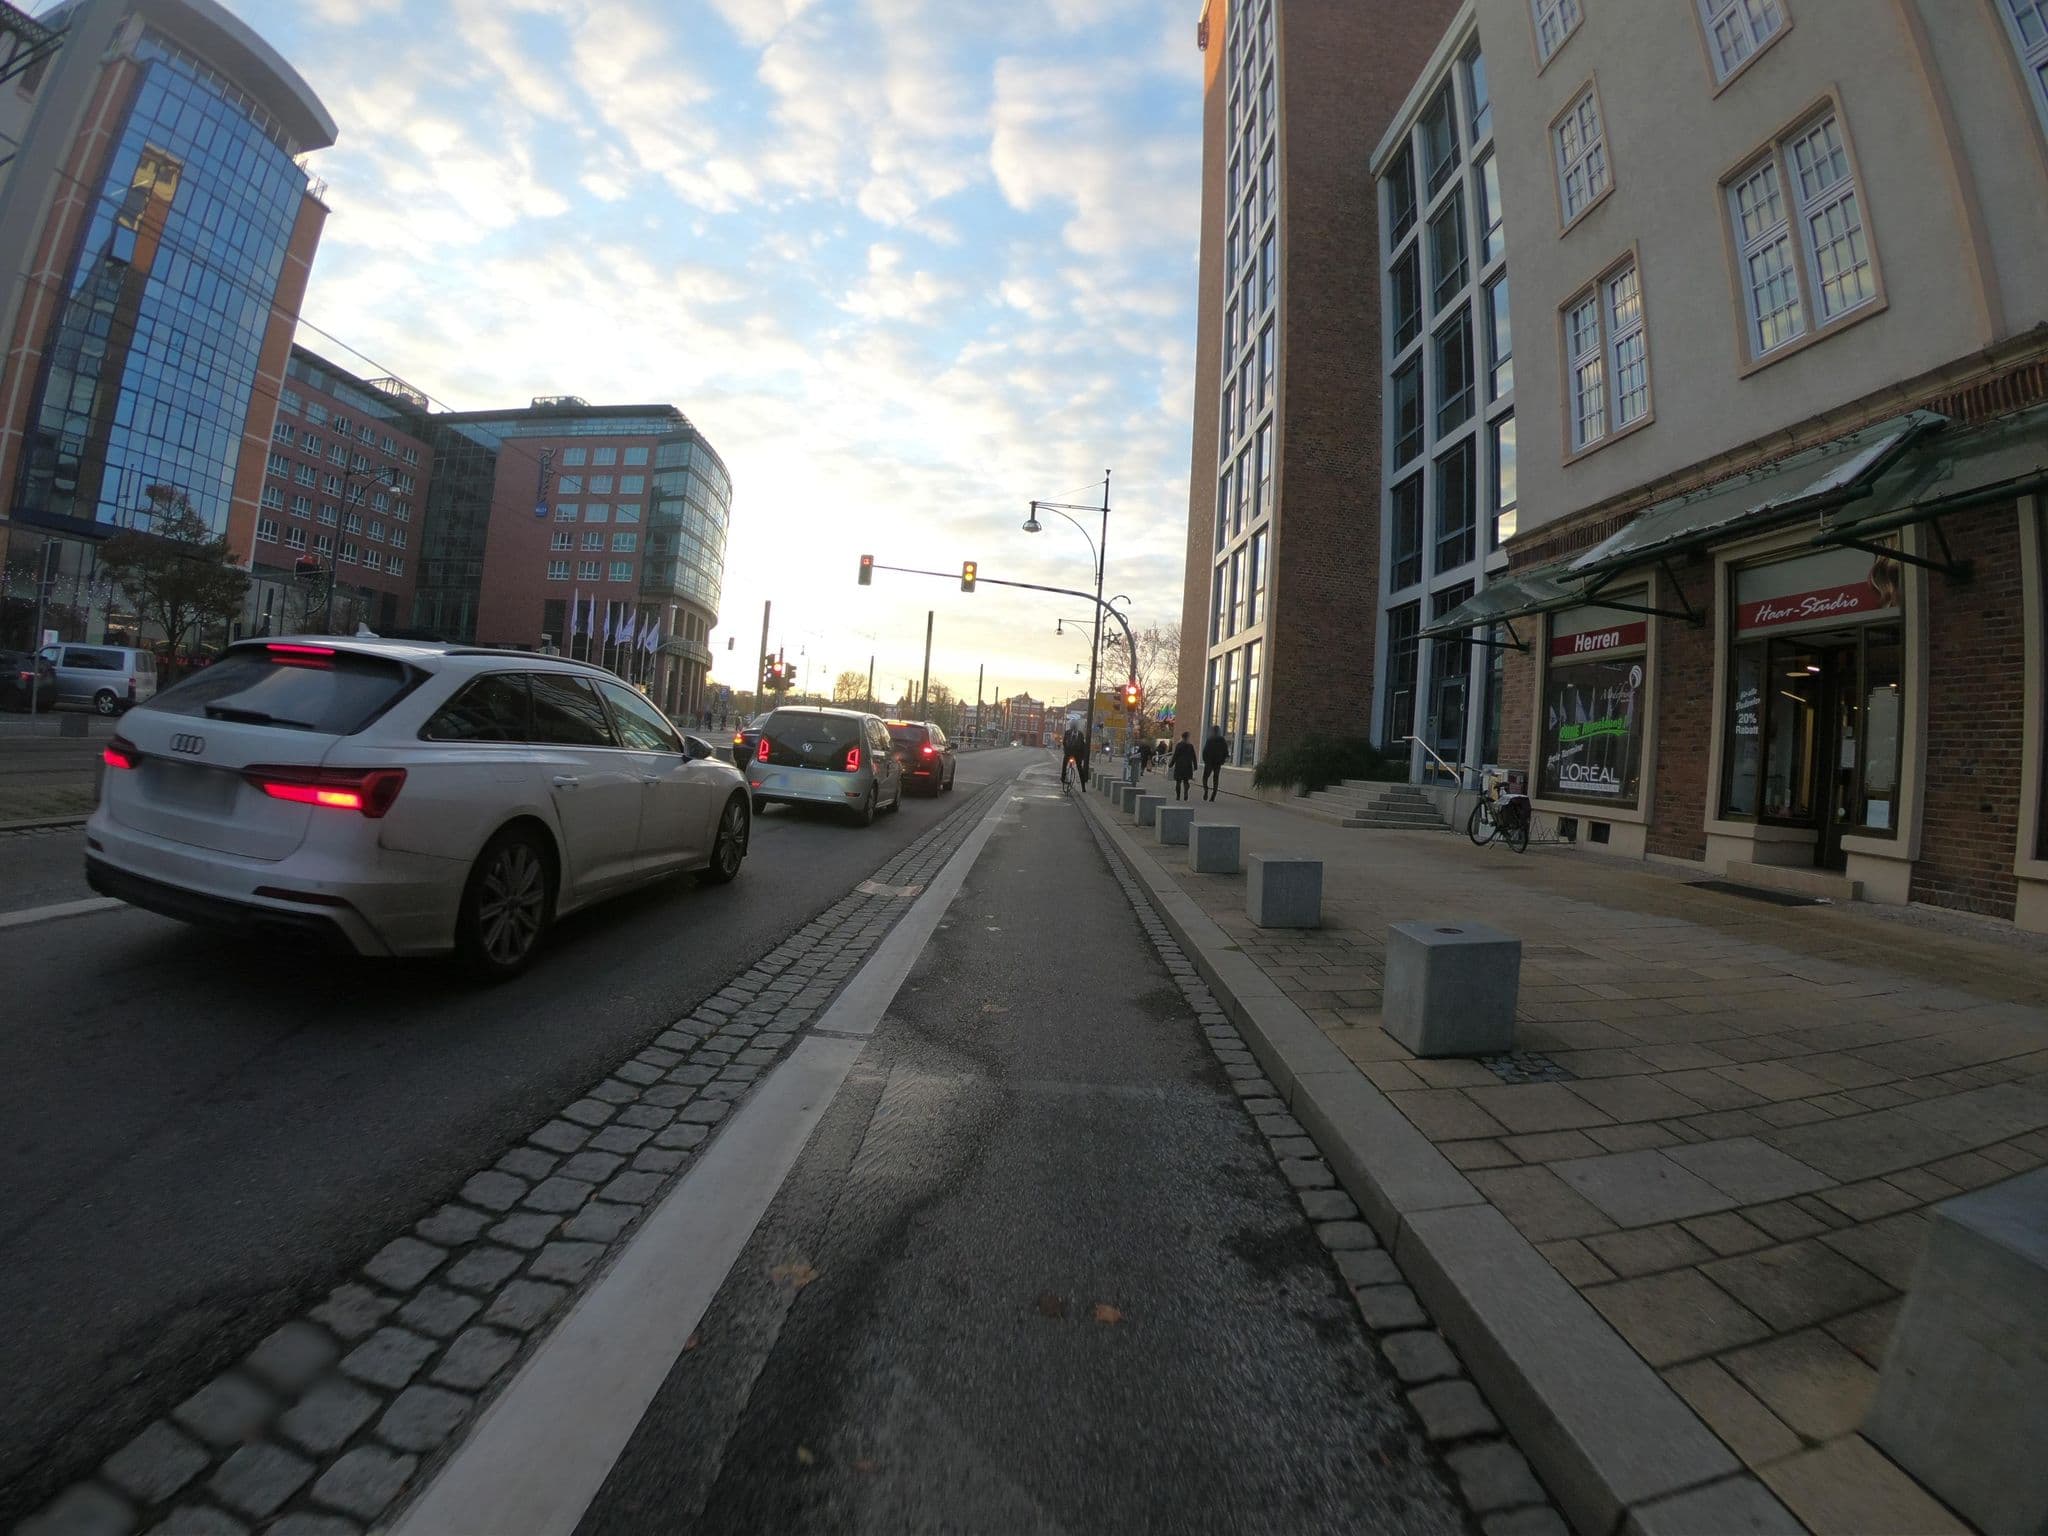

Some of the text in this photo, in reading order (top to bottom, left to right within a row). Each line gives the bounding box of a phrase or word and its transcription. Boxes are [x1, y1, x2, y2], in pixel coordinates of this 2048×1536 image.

[1755, 592, 1859, 623] Haar-Studio
[1574, 631, 1620, 653] Herren
[1738, 713, 1757, 724] 20%
[1735, 725, 1759, 735] Rabatt
[1559, 763, 1620, 783] L'ORÉAL
